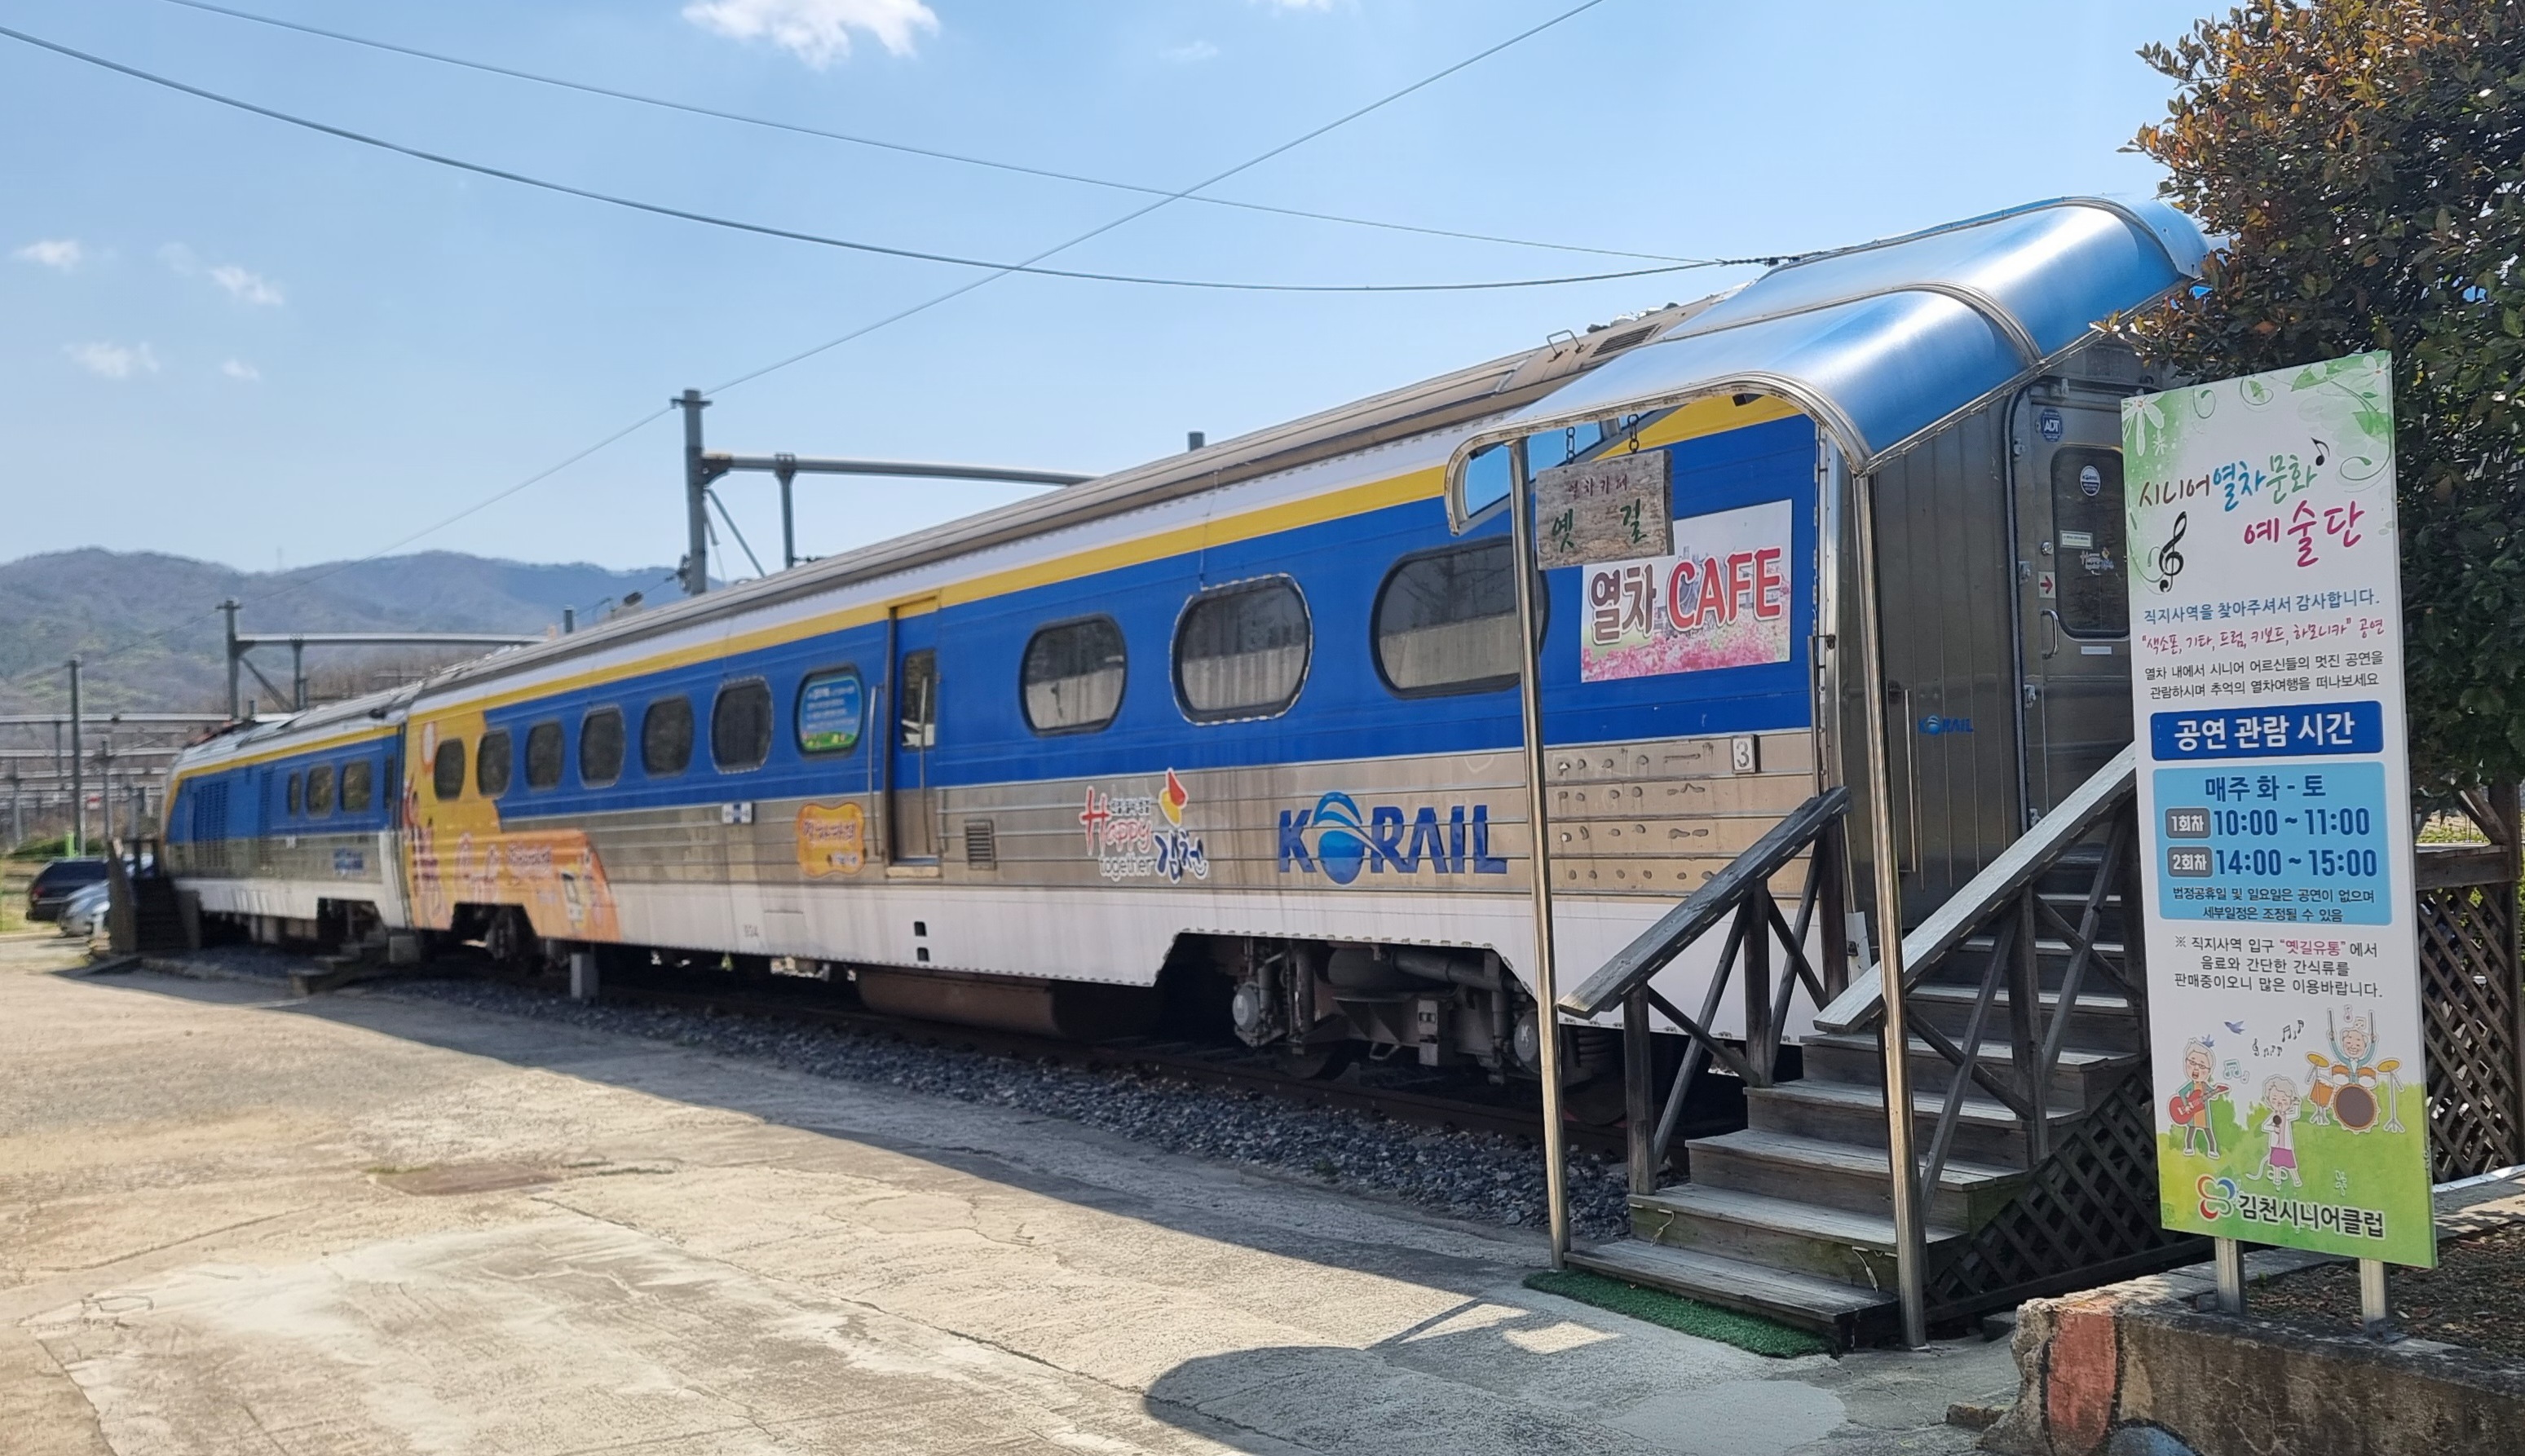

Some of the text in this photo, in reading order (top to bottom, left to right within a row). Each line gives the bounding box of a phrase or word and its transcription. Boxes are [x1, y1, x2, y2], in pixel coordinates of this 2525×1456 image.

[2044, 419, 2059, 432] ADT
[2244, 500, 2365, 567] 예술단
[1591, 548, 1782, 644] 열차 CAFE
[2144, 588, 2380, 624] 직지사역을 찾아주셔서 감사합니다.
[2186, 635, 2215, 651] 기타,
[2219, 631, 2247, 649] 드럼,
[2250, 627, 2289, 646] 키보드,
[2359, 618, 2384, 638] 공연
[2145, 651, 2384, 681] 열차 내에서 시니어 어르신들의 멋진 공연을
[2150, 673, 2379, 699] 관람하시며 추억의 열차여행을 떠나보세요
[2174, 712, 2355, 751] 공연 관람 시간
[1736, 743, 1750, 768] 3
[2205, 776, 2250, 802] 매주
[2257, 775, 2280, 801] 화
[2302, 775, 2326, 796] 토
[1079, 786, 1151, 856] Happy
[2171, 815, 2204, 832] 1회차
[2214, 810, 2278, 836] 10:00
[2305, 808, 2370, 835] 11:00
[1278, 792, 1507, 885] KORAIL
[1099, 853, 1155, 881] together
[2173, 854, 2207, 871] 2회차
[2216, 849, 2281, 876] 14:00
[2308, 849, 2377, 877] 15:00
[2173, 887, 2374, 903] 법정공휴일 및 일요일은 공연이 없으며
[2203, 906, 2343, 922] 세부일정은 조정될 수 있음
[2192, 937, 2242, 952] 직지사역
[2249, 938, 2275, 953] 입구
[2350, 942, 2377, 957] 에서
[2201, 955, 2350, 977] 음료와 간단한 간식류를
[2174, 973, 2382, 998] 판매중이오니 많은 이용바랍니다.
[2239, 1194, 2383, 1238] 김천시니어클럽
